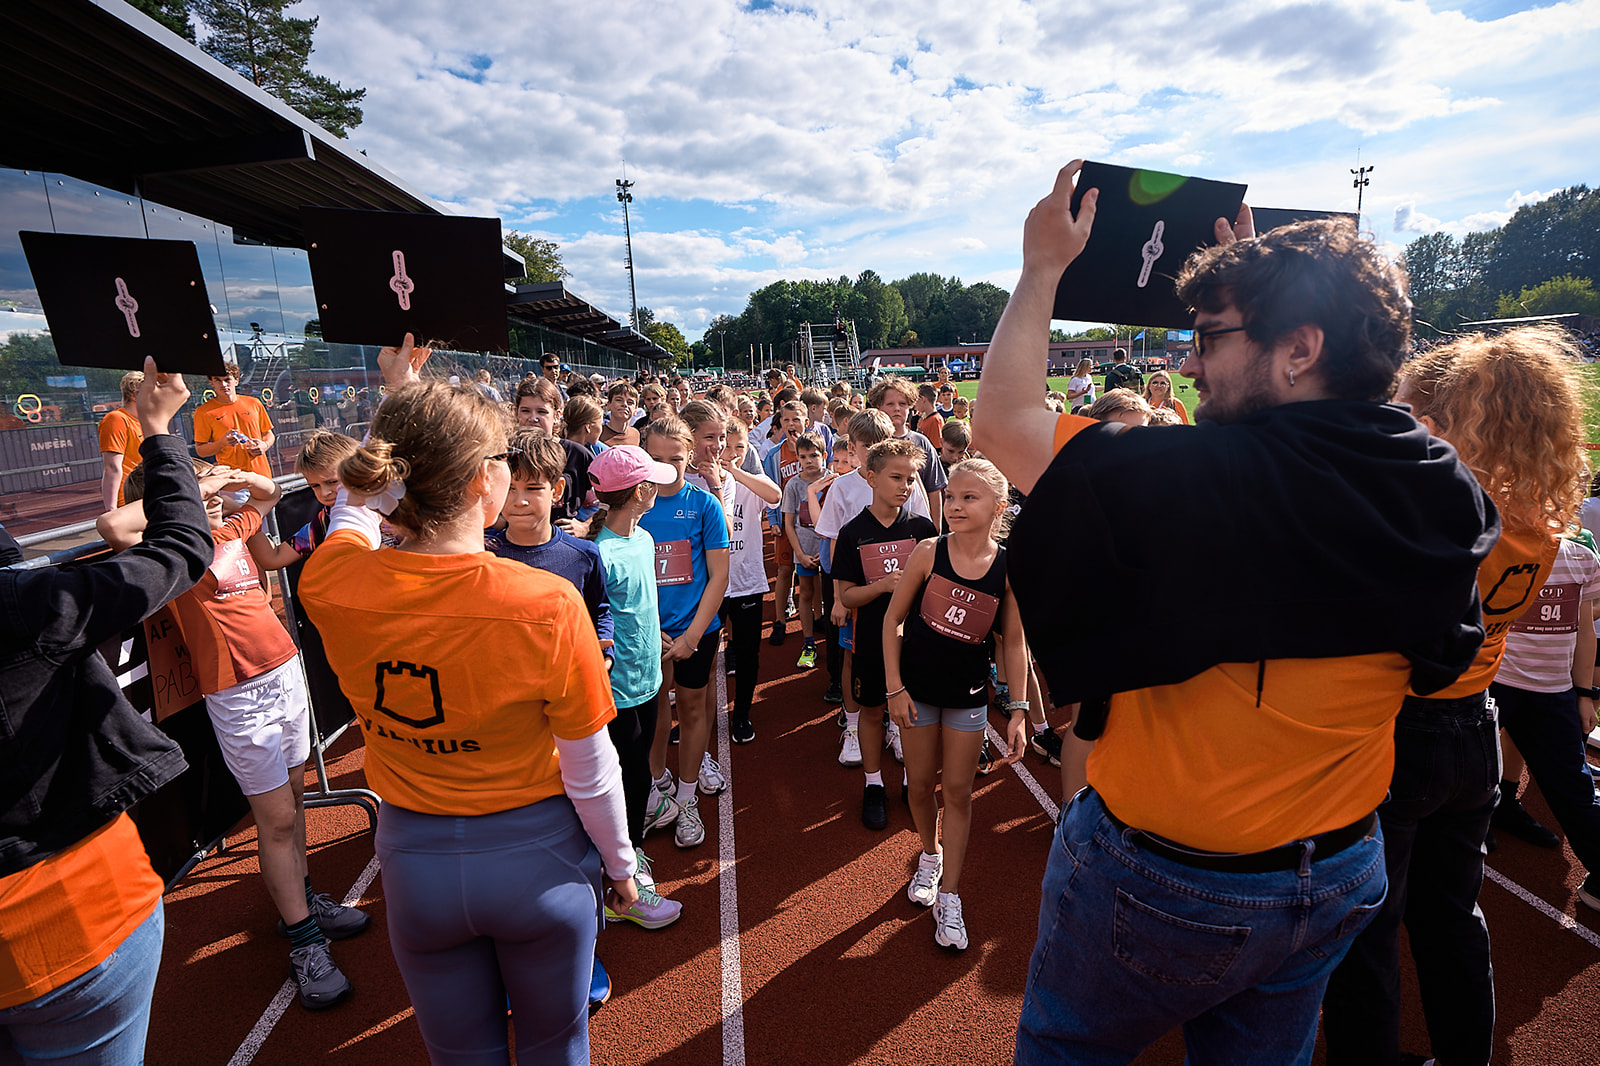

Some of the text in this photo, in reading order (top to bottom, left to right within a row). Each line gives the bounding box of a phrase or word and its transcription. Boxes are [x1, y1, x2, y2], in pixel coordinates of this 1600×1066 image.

[235, 558, 251, 576] 19
[659, 559, 668, 575] 7
[883, 558, 900, 573] 32
[951, 587, 976, 602] CUP
[944, 605, 967, 626] 43
[1540, 604, 1561, 621] 94
